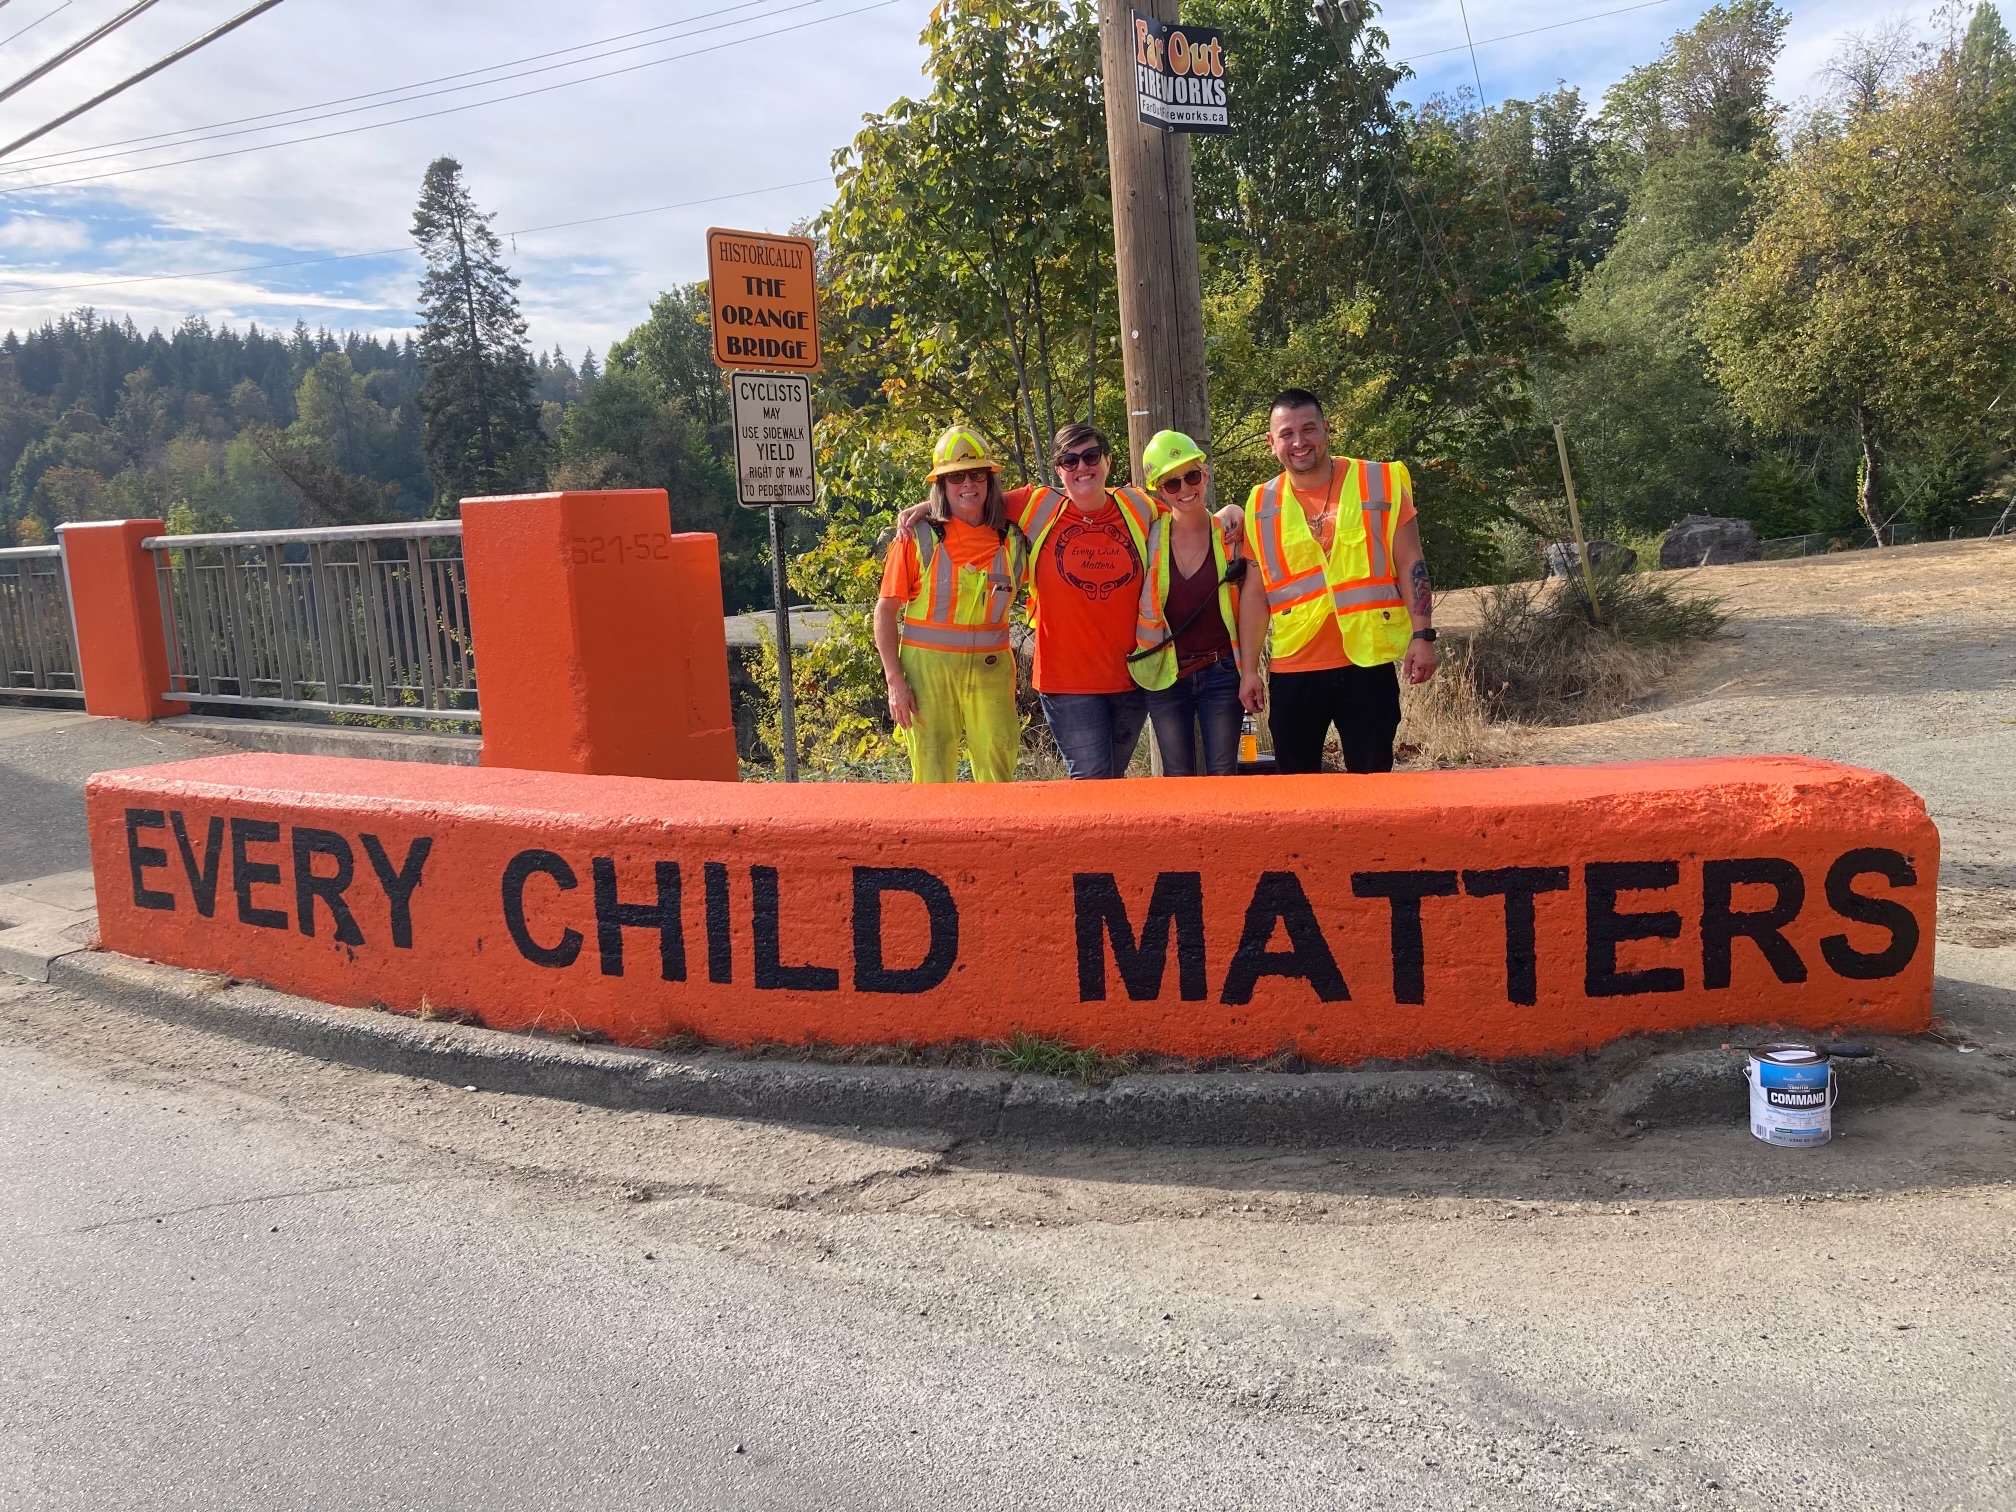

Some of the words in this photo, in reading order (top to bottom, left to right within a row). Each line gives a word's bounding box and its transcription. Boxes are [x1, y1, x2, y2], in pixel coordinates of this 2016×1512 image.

[1136, 19, 1164, 72] Far
[1168, 31, 1223, 77] Out
[1138, 64, 1227, 106] FIREWORKS
[719, 241, 803, 269] HISTORICALLY
[742, 275, 786, 298] THE
[722, 305, 809, 330] ORANGE
[727, 336, 808, 360] BRIDGE
[741, 382, 802, 402] CYCLISTS
[763, 407, 781, 420] MAY
[742, 426, 760, 439] USE
[763, 426, 804, 440] SIDEWALK
[757, 443, 795, 461] YIELD
[749, 466, 773, 479] RIGHT
[775, 467, 786, 479] OF
[789, 467, 803, 479] WAY
[745, 484, 755, 497] TO
[758, 484, 811, 497] PEDESTRIANS
[1071, 546, 1095, 560] Every
[1080, 560, 1115, 570] Matters
[125, 808, 433, 949] EVERY
[502, 849, 959, 994] CHILD
[1072, 848, 1920, 1006] MATTERS
[1770, 1091, 1825, 1106] COMMAND
